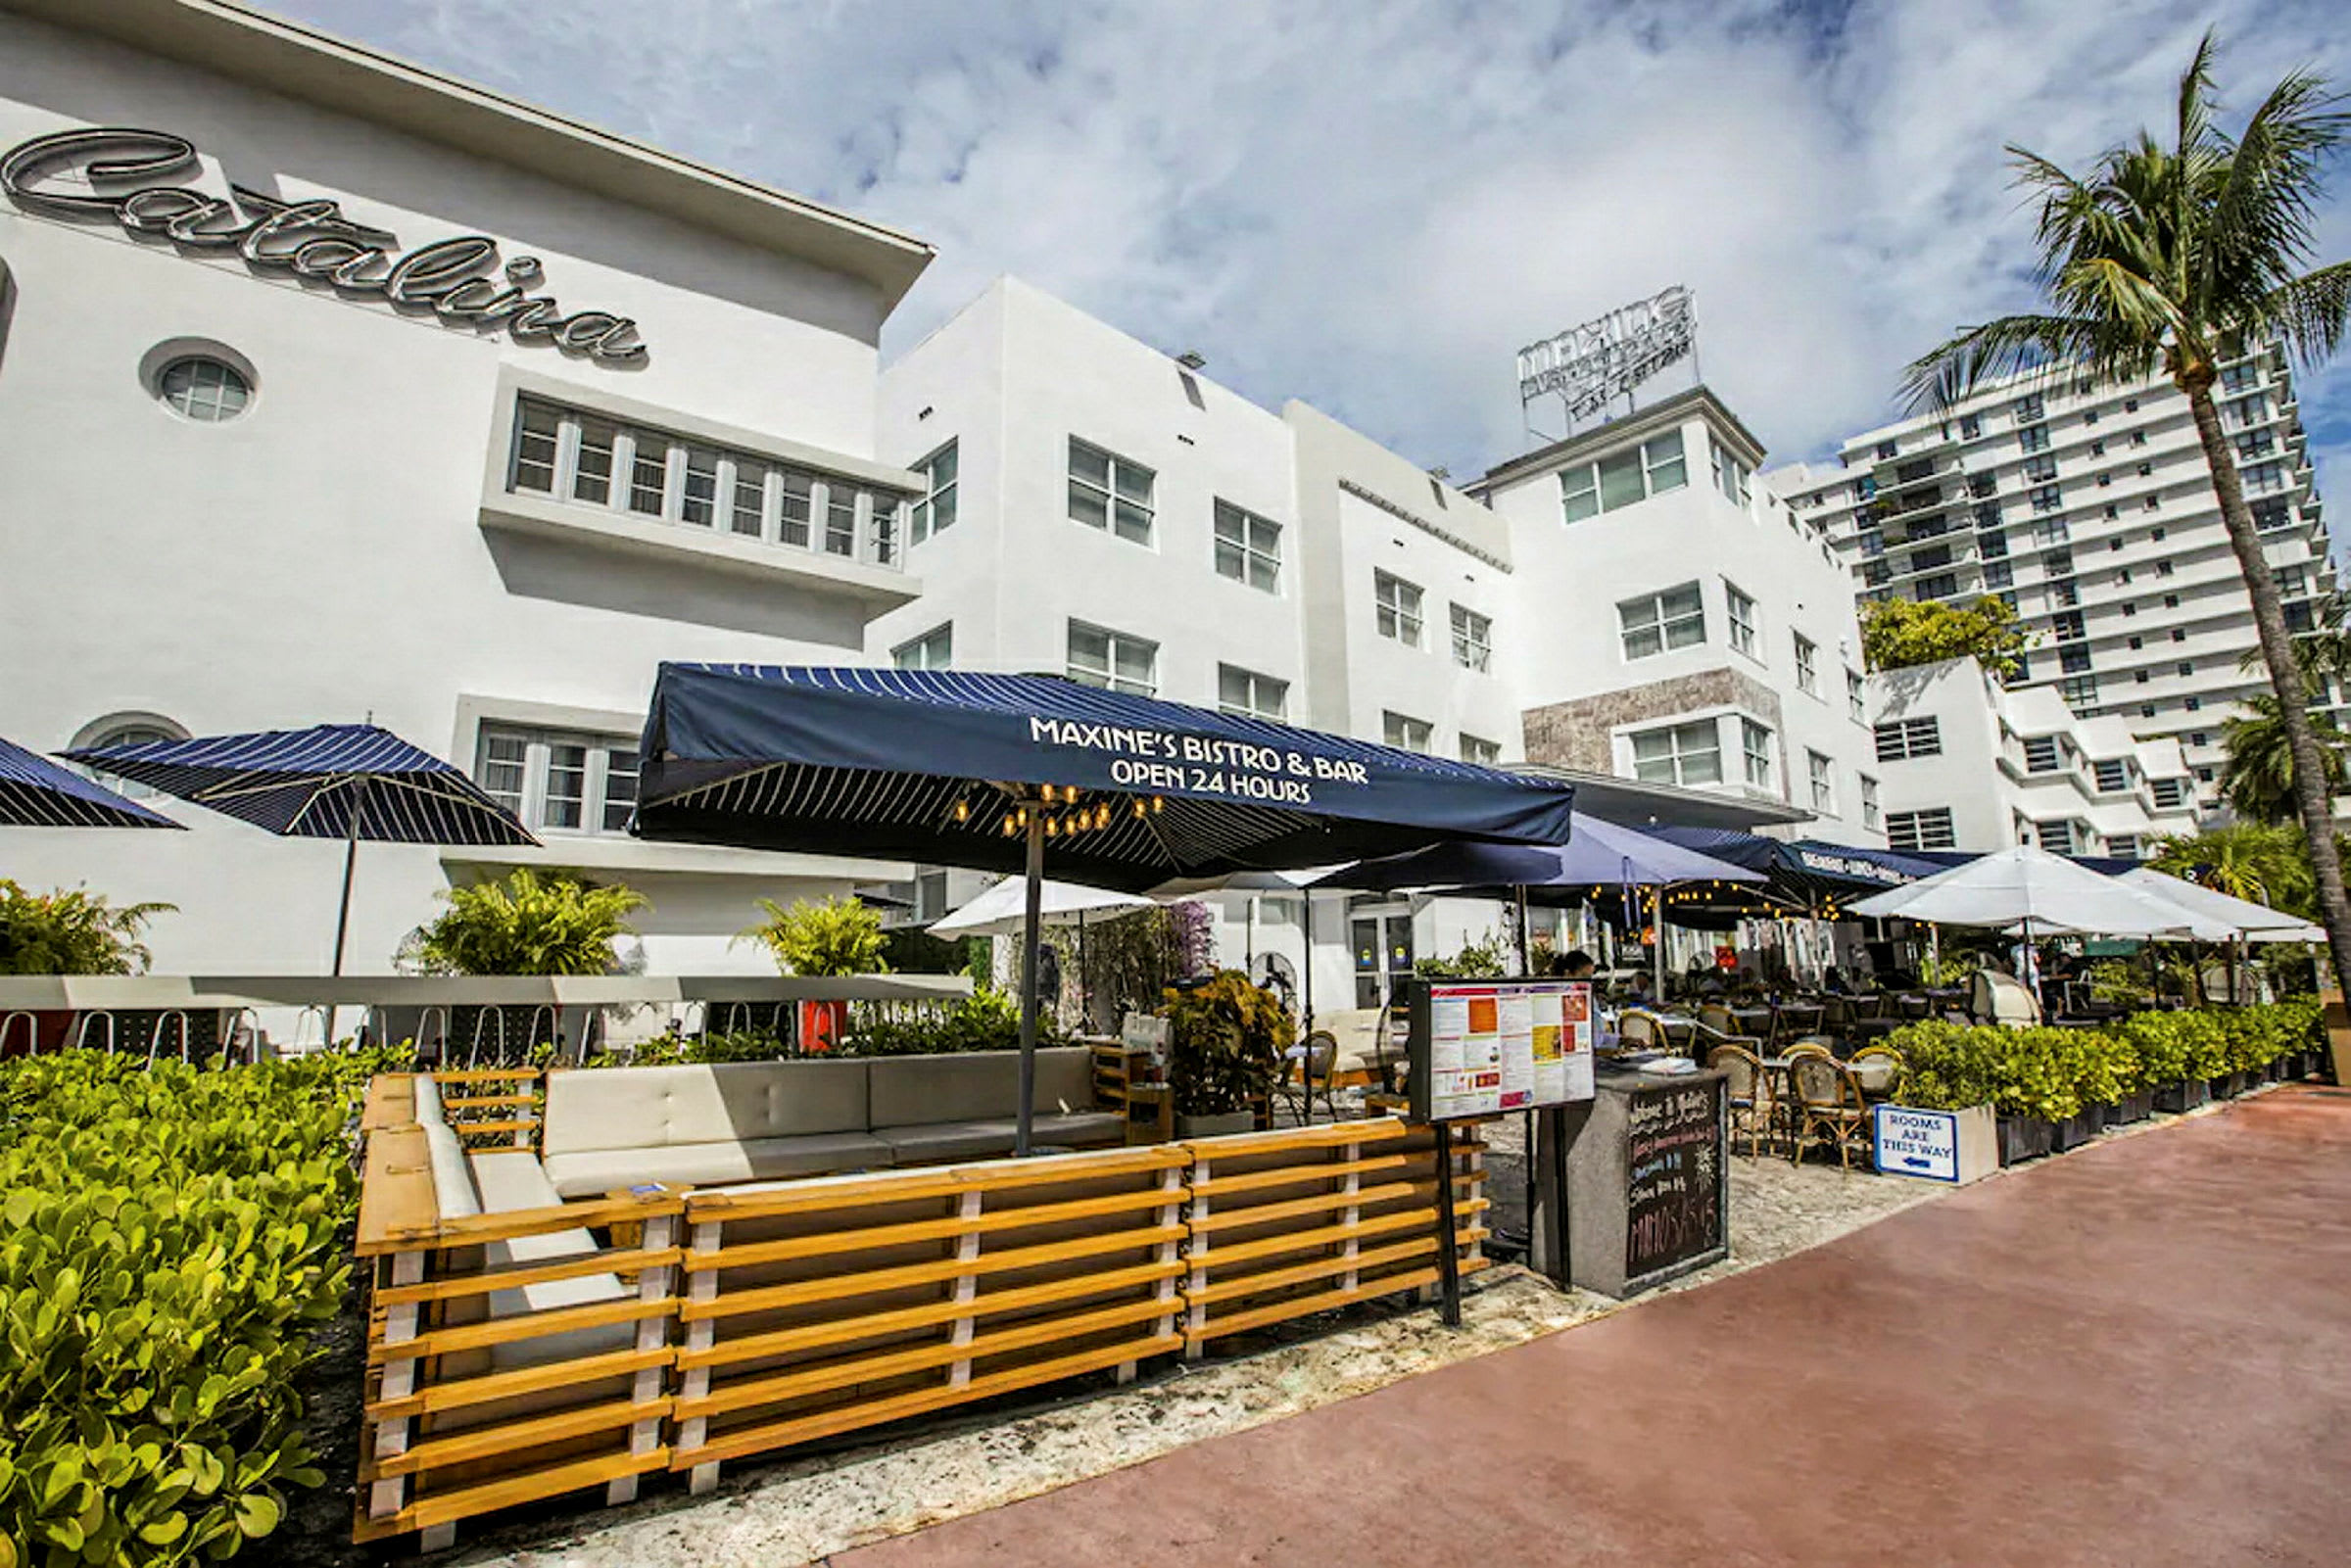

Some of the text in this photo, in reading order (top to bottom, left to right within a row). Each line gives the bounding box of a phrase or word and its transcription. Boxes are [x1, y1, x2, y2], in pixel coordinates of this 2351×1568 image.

[0, 127, 648, 370] Catalina
[1030, 716, 1369, 784] MAXINE'S BISTRO & BAR
[1111, 759, 1312, 804] OPEN 24 HOURS
[1890, 1115, 1941, 1130] ROOMS
[1902, 1130, 1928, 1141] ARE
[1884, 1139, 1952, 1158] THIS WAY
